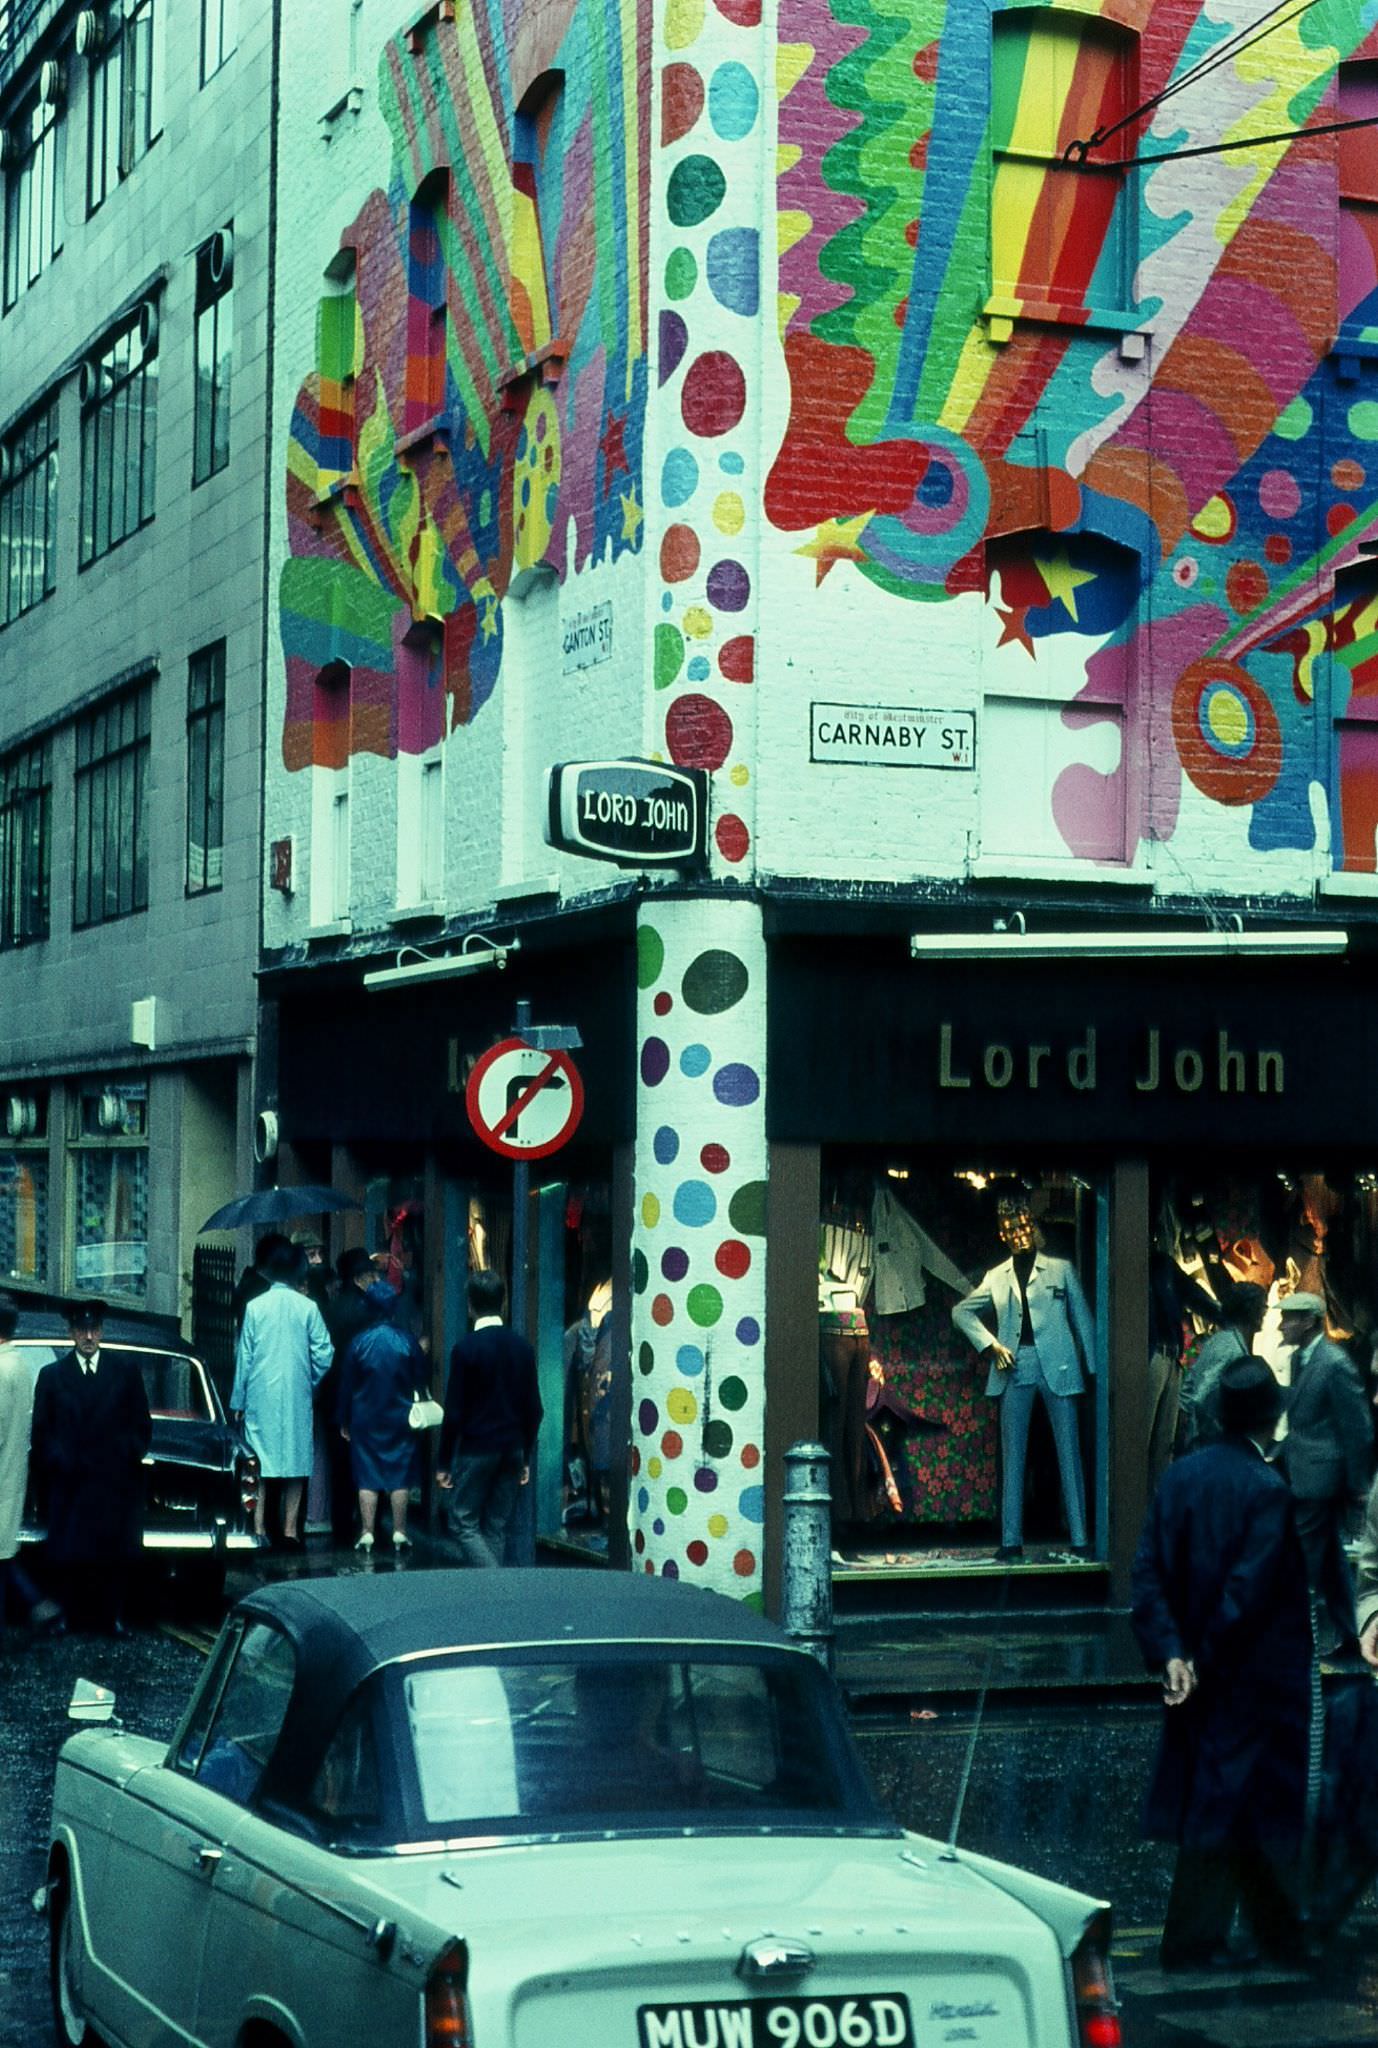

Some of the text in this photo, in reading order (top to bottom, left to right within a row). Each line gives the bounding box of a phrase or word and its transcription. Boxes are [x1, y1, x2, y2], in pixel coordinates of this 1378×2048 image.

[562, 624, 596, 654] GANTON
[818, 722, 970, 750] CARNABY ST.
[583, 789, 637, 826] LORD
[939, 1023, 1285, 1092] Lord John
[644, 2008, 753, 2048] MUW
[766, 2000, 906, 2048] 906D
